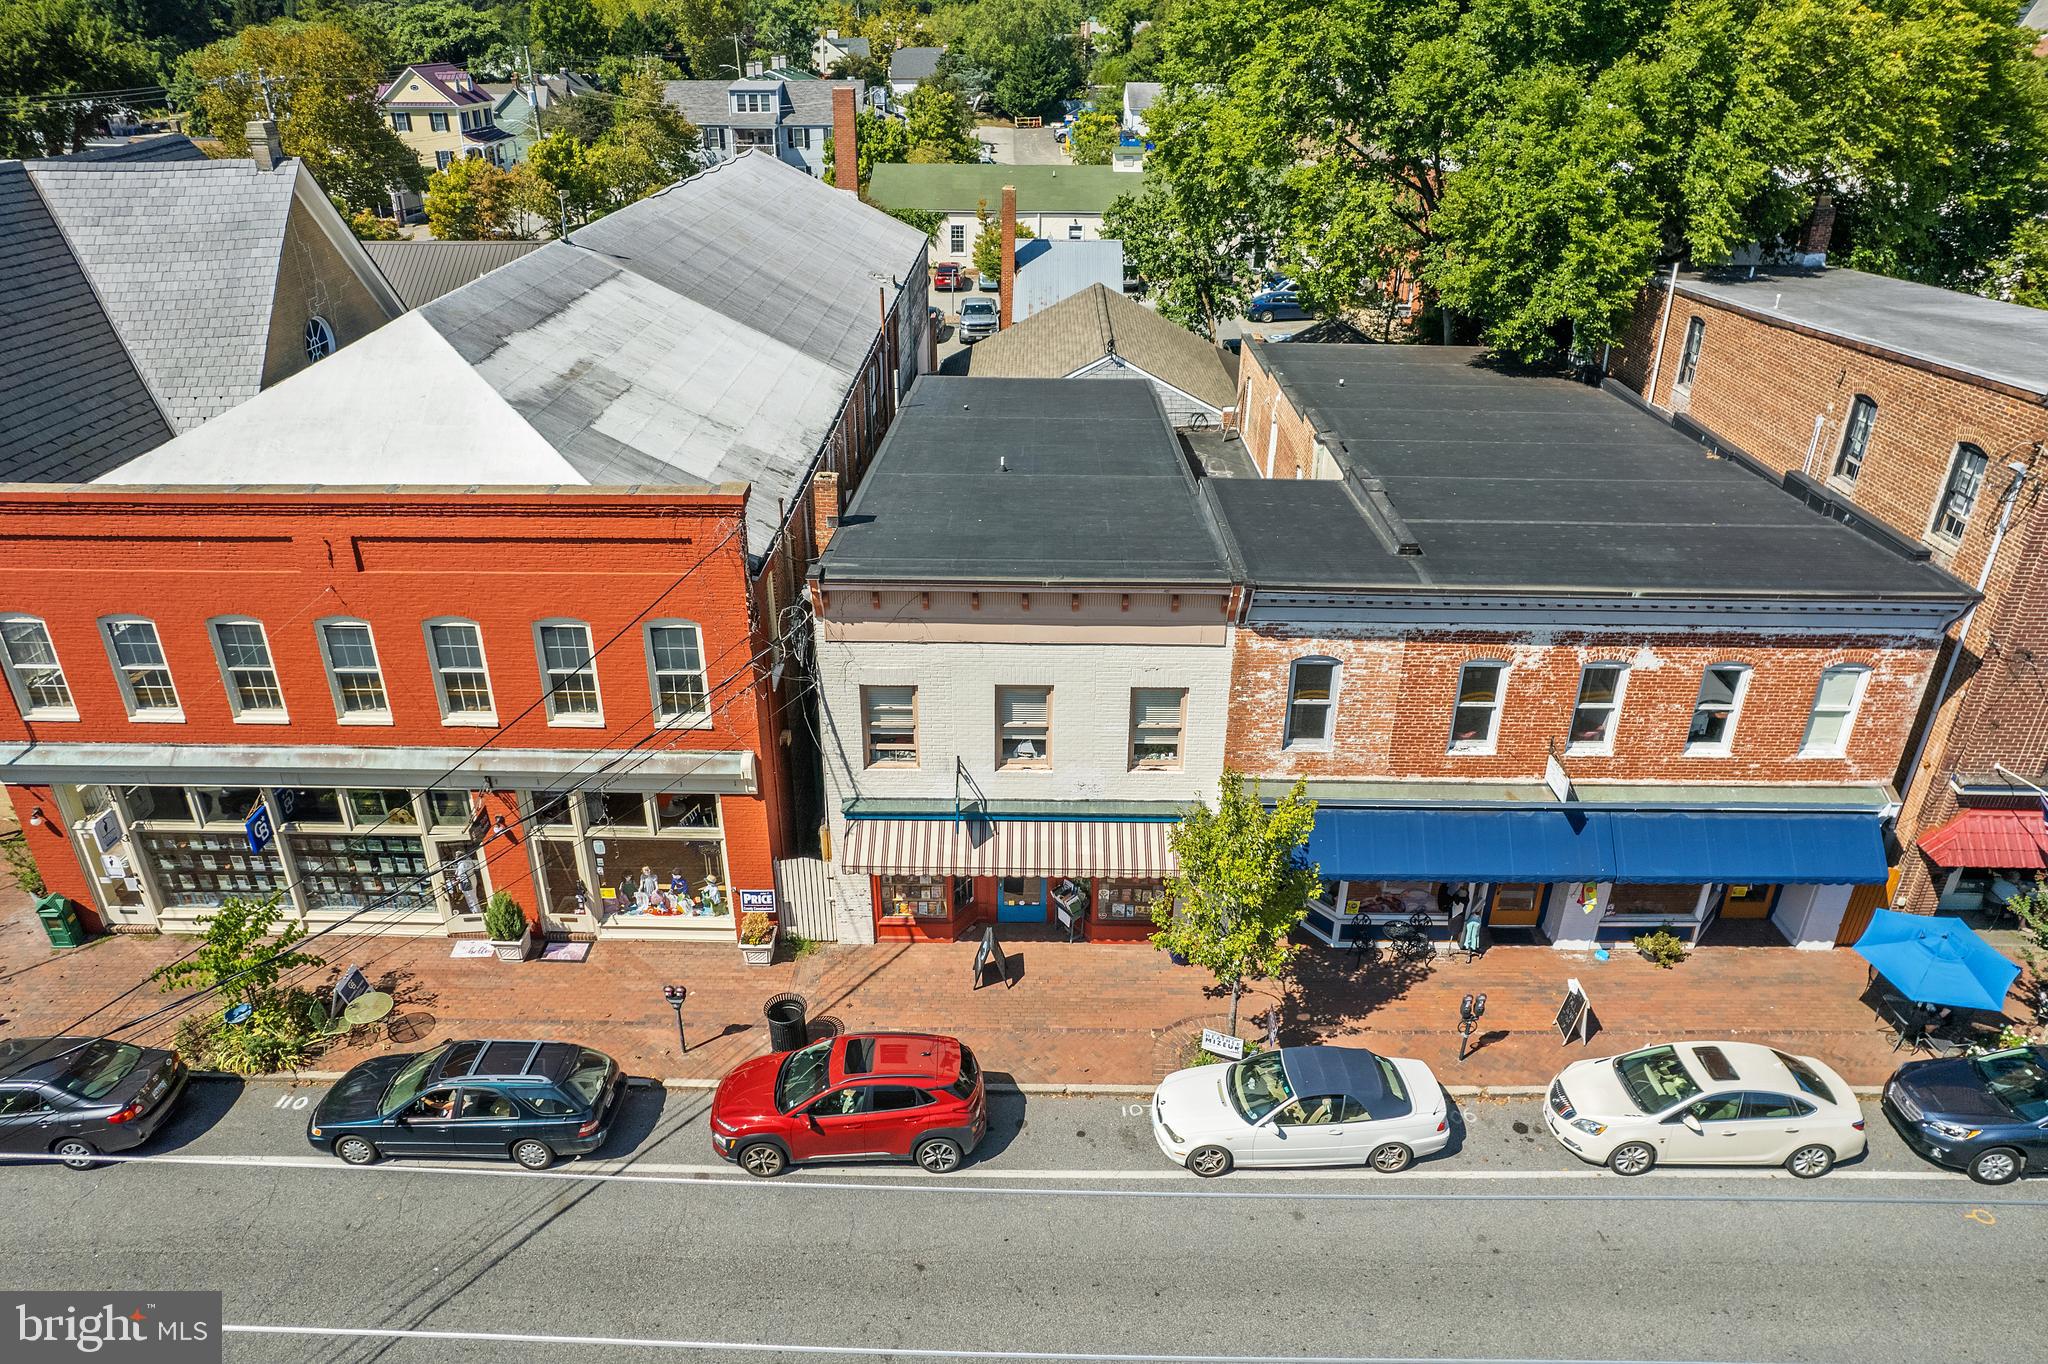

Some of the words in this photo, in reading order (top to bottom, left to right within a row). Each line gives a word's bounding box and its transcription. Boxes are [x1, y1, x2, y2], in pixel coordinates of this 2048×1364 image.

[743, 893, 773, 905] PRICE
[1205, 1037, 1240, 1052] MIZEUR
[273, 1094, 309, 1110] 110
